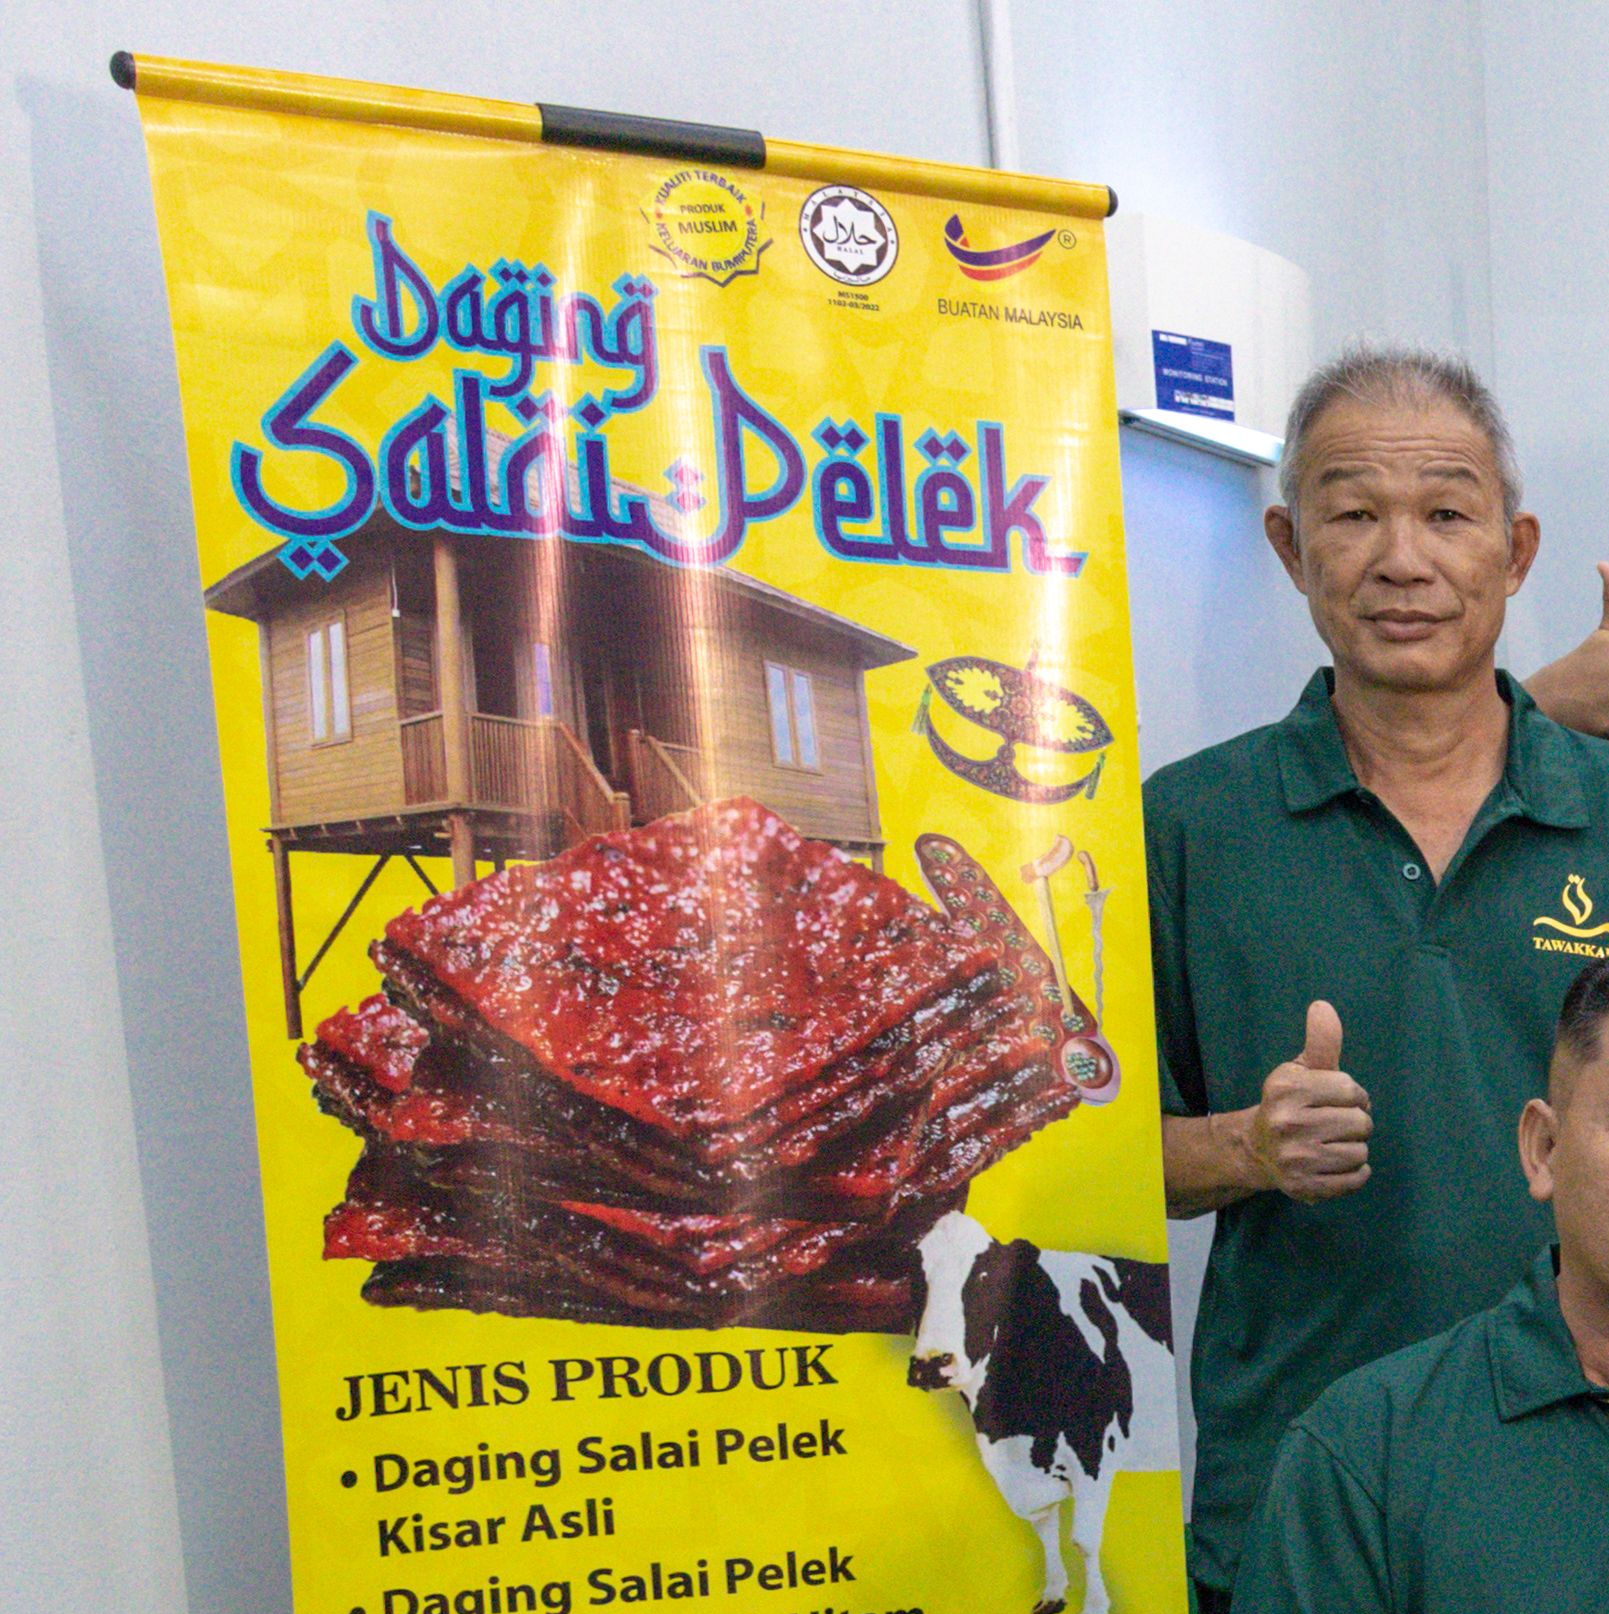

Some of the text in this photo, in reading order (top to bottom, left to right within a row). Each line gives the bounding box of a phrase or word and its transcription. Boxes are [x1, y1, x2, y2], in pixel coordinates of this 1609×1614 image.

[655, 169, 746, 206] KUALITI TERBAIK
[680, 204, 725, 213] PRODUK
[678, 220, 737, 234] MUSLIM
[937, 298, 1084, 330] BUATAN MALAYSIA
[336, 1344, 838, 1421] JENIS PRODUK
[374, 1419, 847, 1494] Daging Salai Pelek
[378, 1497, 614, 1557] Kisar Asli
[588, 1559, 709, 1605] Salai
[725, 1547, 856, 1594] Pelek
